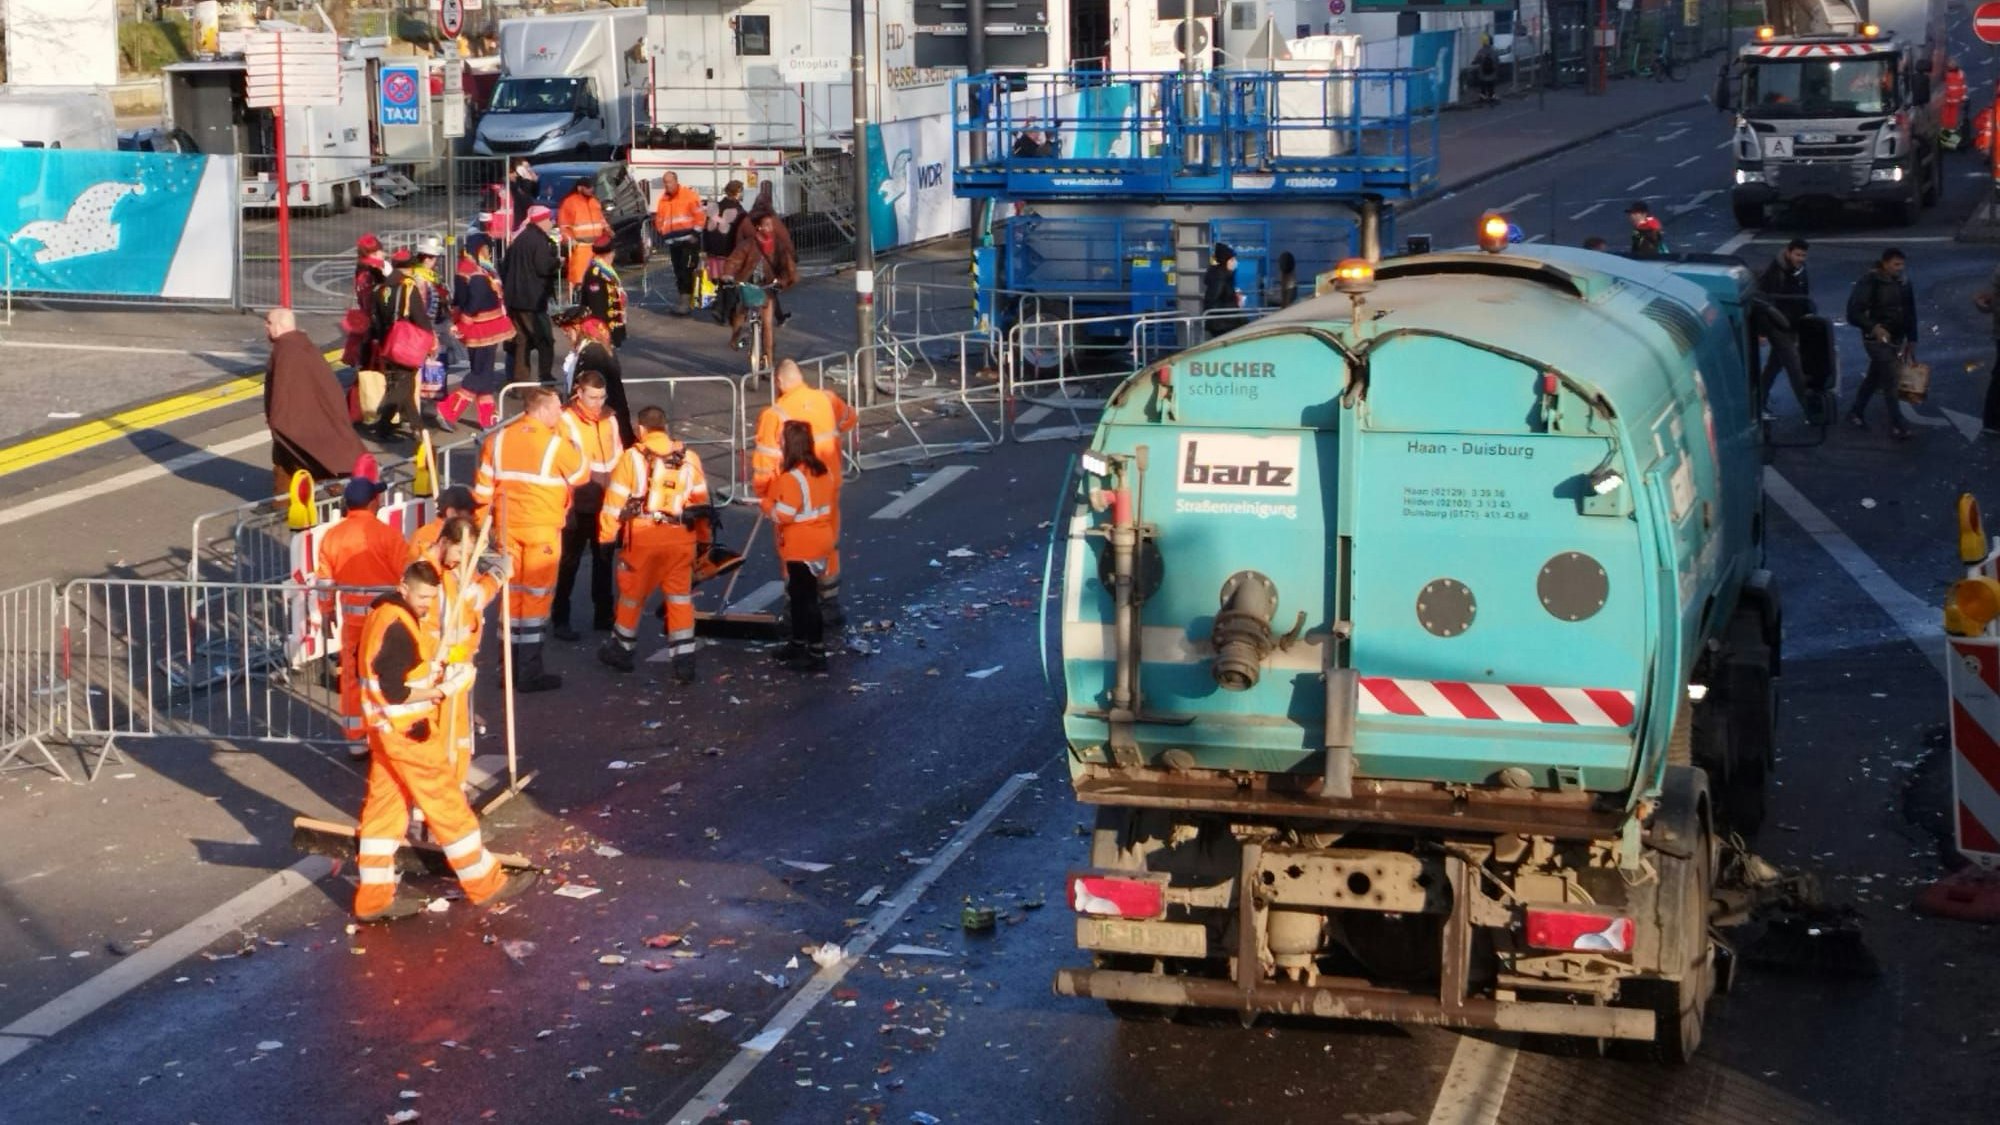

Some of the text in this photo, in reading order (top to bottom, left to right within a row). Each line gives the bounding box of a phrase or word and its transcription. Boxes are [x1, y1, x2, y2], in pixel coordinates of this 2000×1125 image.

[790, 59, 839, 70] Ottoplatz
[385, 107, 418, 121] TAXI
[1773, 140, 1786, 154] A
[917, 162, 943, 189] WDR
[1285, 176, 1337, 188] mateco
[1189, 361, 1276, 378] BUCHER
[1189, 381, 1259, 400] schörling
[1407, 440, 1447, 454] Haan
[1462, 442, 1534, 459] Duisburg
[1183, 441, 1294, 486] bartz
[1176, 498, 1297, 519] Straßenreinigung
